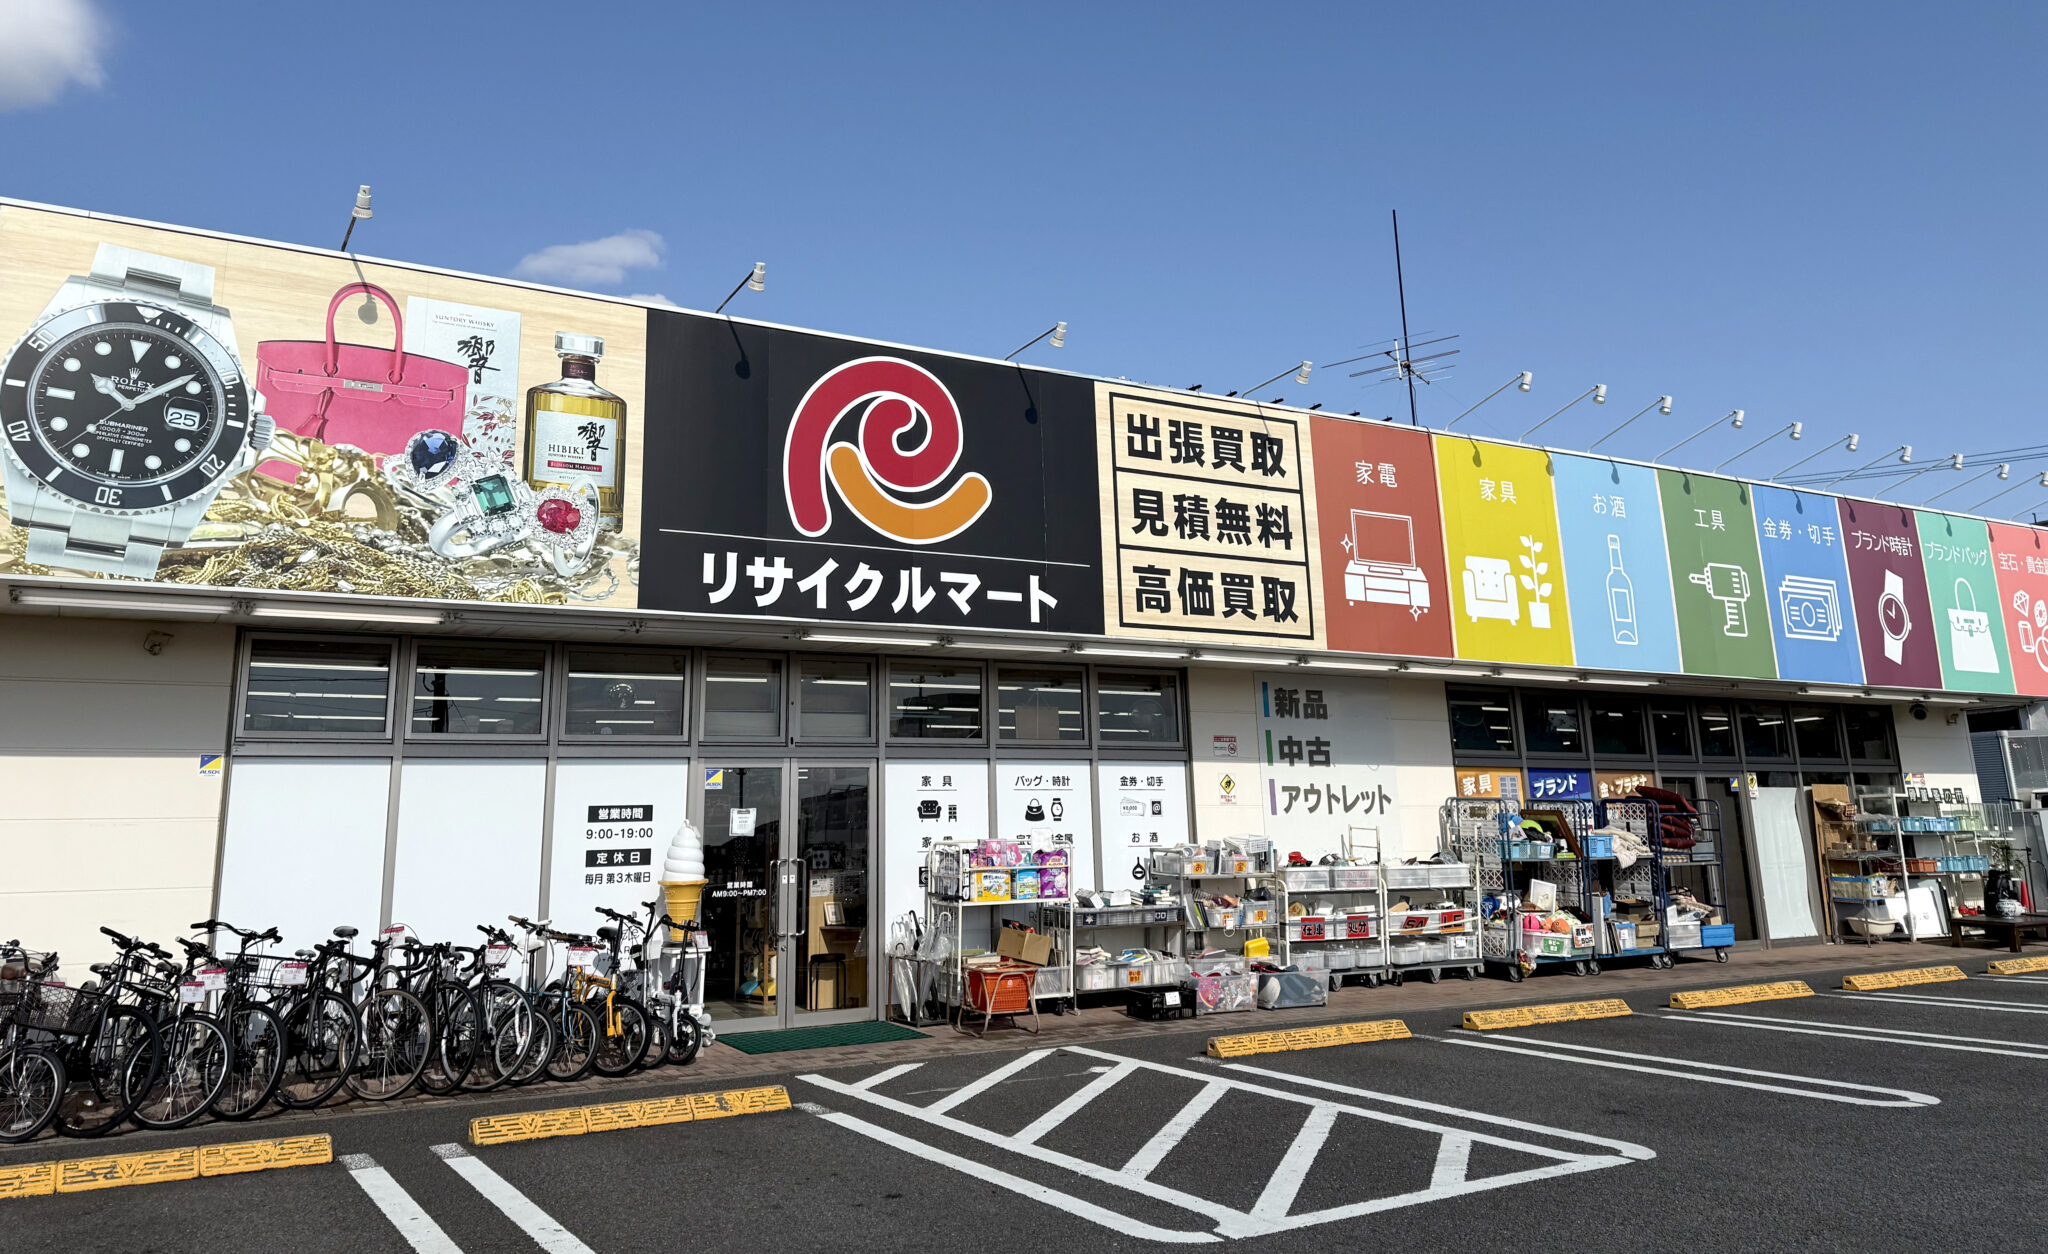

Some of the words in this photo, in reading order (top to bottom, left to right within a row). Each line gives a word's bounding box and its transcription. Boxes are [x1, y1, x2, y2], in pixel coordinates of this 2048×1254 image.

[27, 328, 57, 352] 50
[111, 375, 156, 389] ROLEX
[168, 411, 198, 428] 25
[548, 444, 584, 455] HIBIKI
[1126, 412, 1288, 479] 出張買取
[200, 454, 226, 477] 20
[1355, 460, 1398, 488] 家電
[95, 486, 122, 505] 30
[1479, 477, 1517, 504] 家具
[1592, 493, 1626, 519] お酒
[1130, 487, 1294, 550] 見積無料
[1694, 508, 1726, 532] 工具
[1762, 517, 1836, 546] 金券・切手
[1851, 530, 1913, 557] ブランド時計
[1925, 541, 1988, 567] ブランドバッグ
[701, 551, 1058, 624] リサイクルマート
[1134, 564, 1300, 625] 高価買取
[1273, 687, 1328, 720] 新品
[1278, 735, 1331, 767] 中古
[921, 775, 953, 787] 家具
[1015, 775, 1071, 787] バッグ・時計
[1119, 775, 1164, 787] 金券・切手
[1462, 774, 1492, 796] 家具
[1533, 773, 1578, 798] ブランド
[1281, 783, 1392, 816] アウトレット
[598, 807, 644, 820] 営業時間
[586, 827, 653, 840] 9:00-19:00
[1131, 832, 1159, 843] お酒
[596, 851, 641, 865] 定休日
[585, 873, 603, 885] 毎月
[606, 871, 651, 885] 第3木曜日
[726, 881, 753, 889] 営業時間
[1347, 921, 1367, 933] 処分
